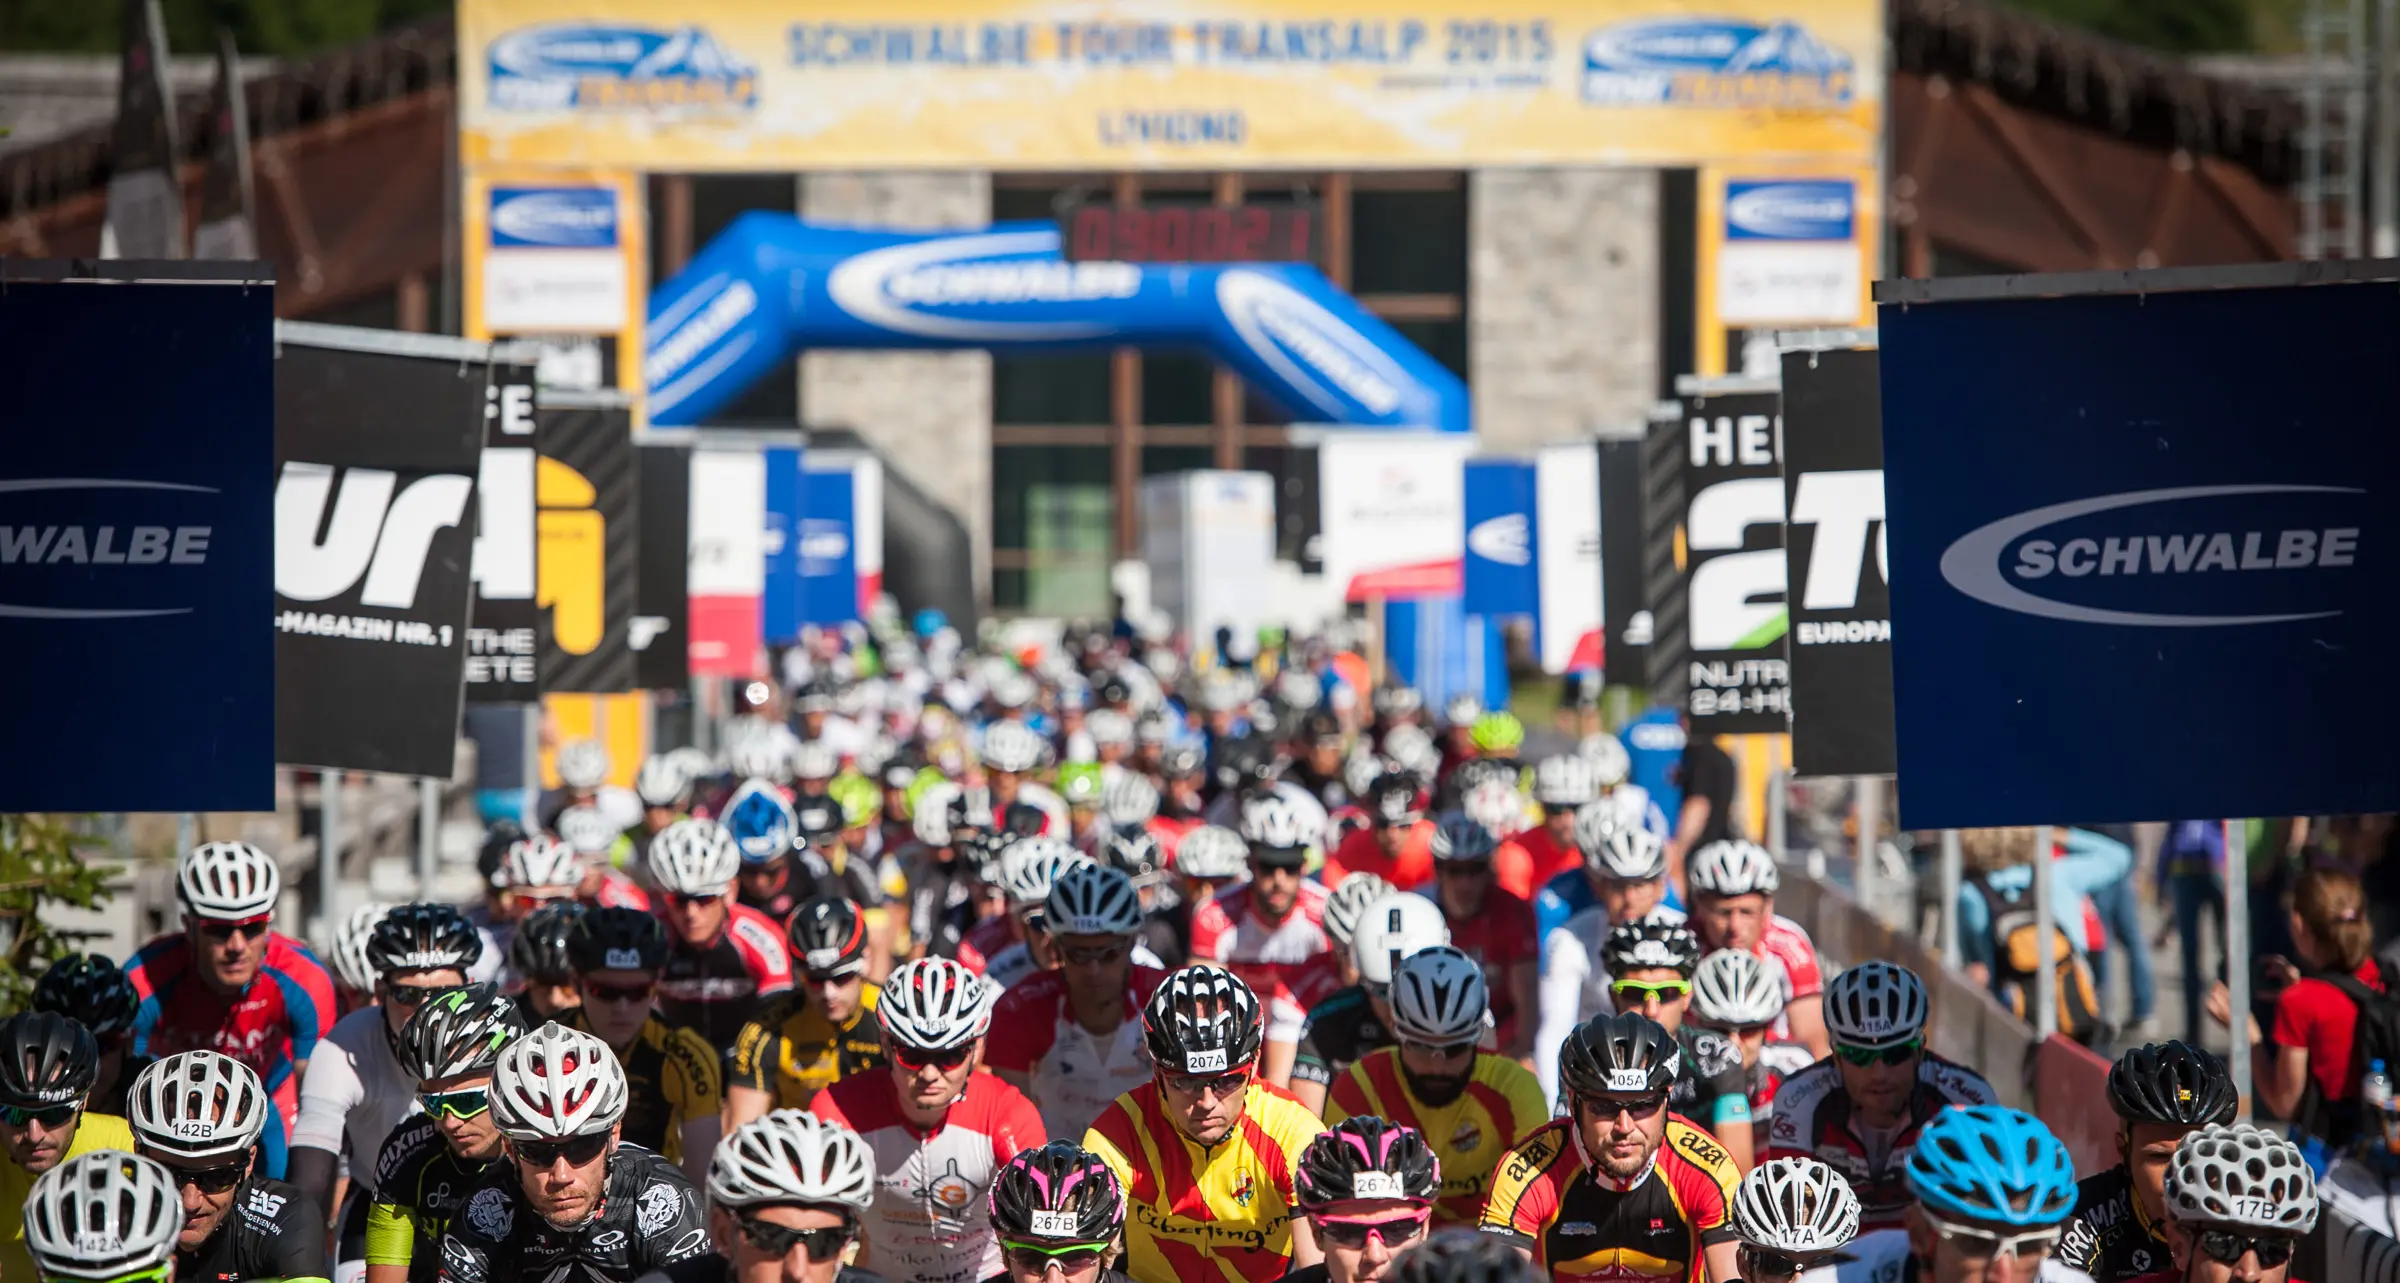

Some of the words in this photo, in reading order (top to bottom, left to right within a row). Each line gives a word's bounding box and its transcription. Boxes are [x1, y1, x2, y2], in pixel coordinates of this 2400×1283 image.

[788, 22, 1029, 66] SCHWALBE
[1058, 22, 1172, 65] TOUR
[1195, 20, 1427, 64] TRANSALP
[1444, 18, 1553, 63] 2015
[2014, 527, 2360, 579] SCHWALBE
[1189, 1055, 1226, 1070] 207A
[1611, 1074, 1645, 1087] 105A
[172, 1121, 213, 1139] 142B
[1357, 1179, 1400, 1193] 267A
[2236, 1200, 2277, 1220] 17B
[1034, 1216, 1074, 1231] 267B
[1741, 1216, 1759, 1241] uvex
[1835, 1221, 1853, 1243] uvex
[1781, 1228, 1815, 1245] 17A
[74, 1238, 124, 1254] 142A
